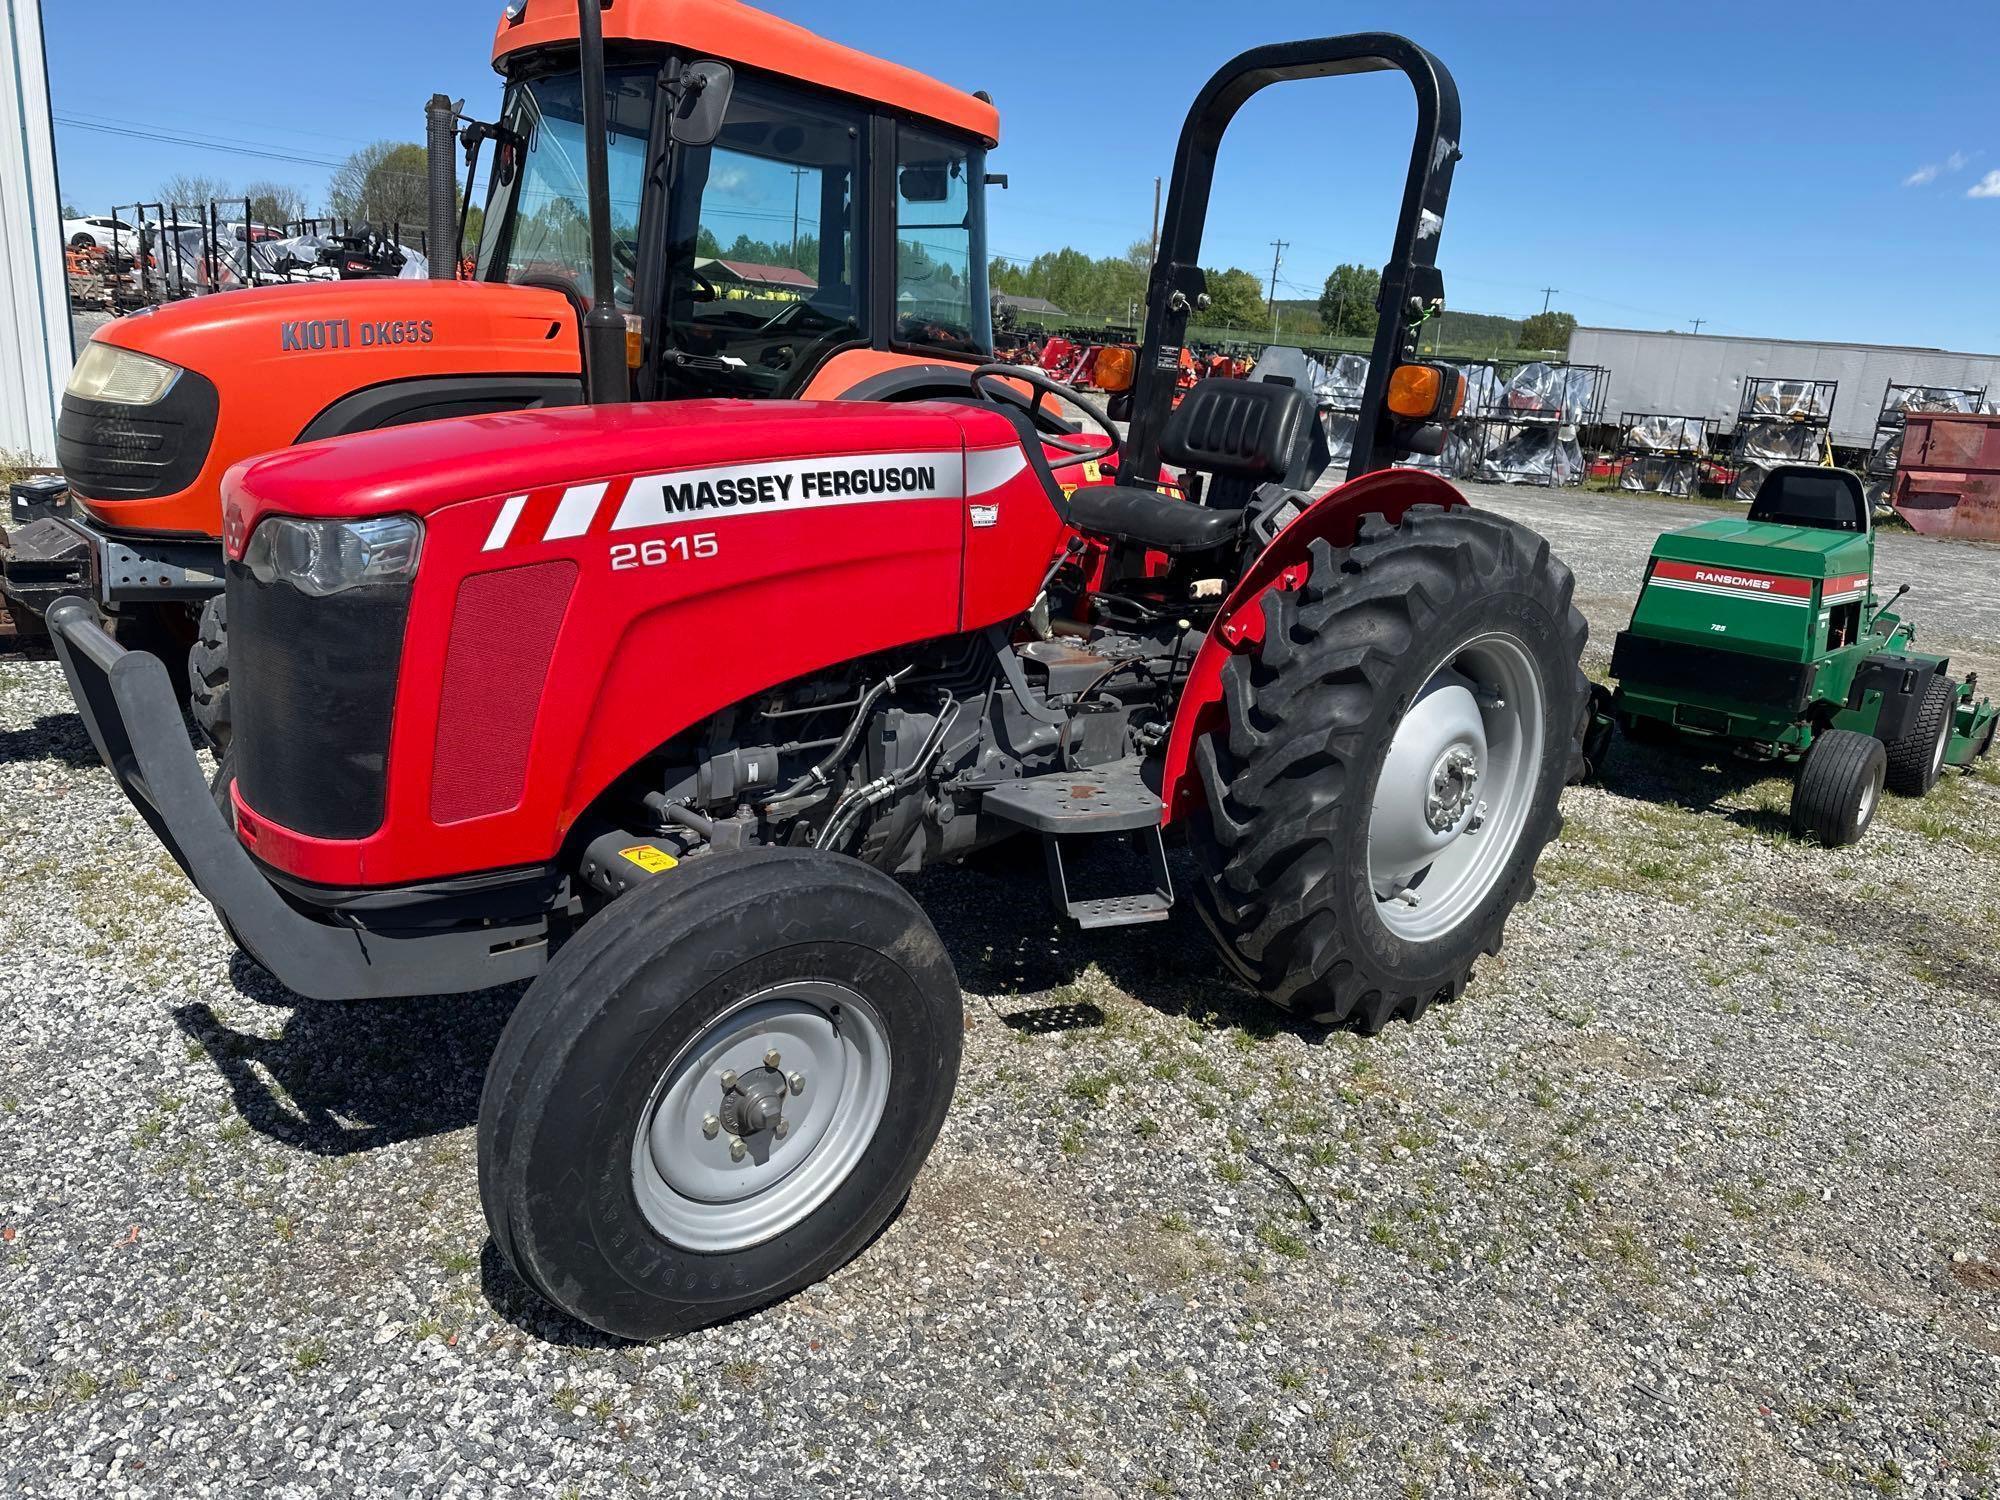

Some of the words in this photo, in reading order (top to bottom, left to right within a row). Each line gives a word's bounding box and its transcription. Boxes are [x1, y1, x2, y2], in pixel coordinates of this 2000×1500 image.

[282, 319, 351, 351] KIOTI
[360, 320, 434, 346] DK65S
[662, 474, 794, 514] MASSEY
[801, 466, 936, 499] FERGUSON
[610, 532, 719, 571] 2615
[1695, 571, 1771, 590] RANSOMES
